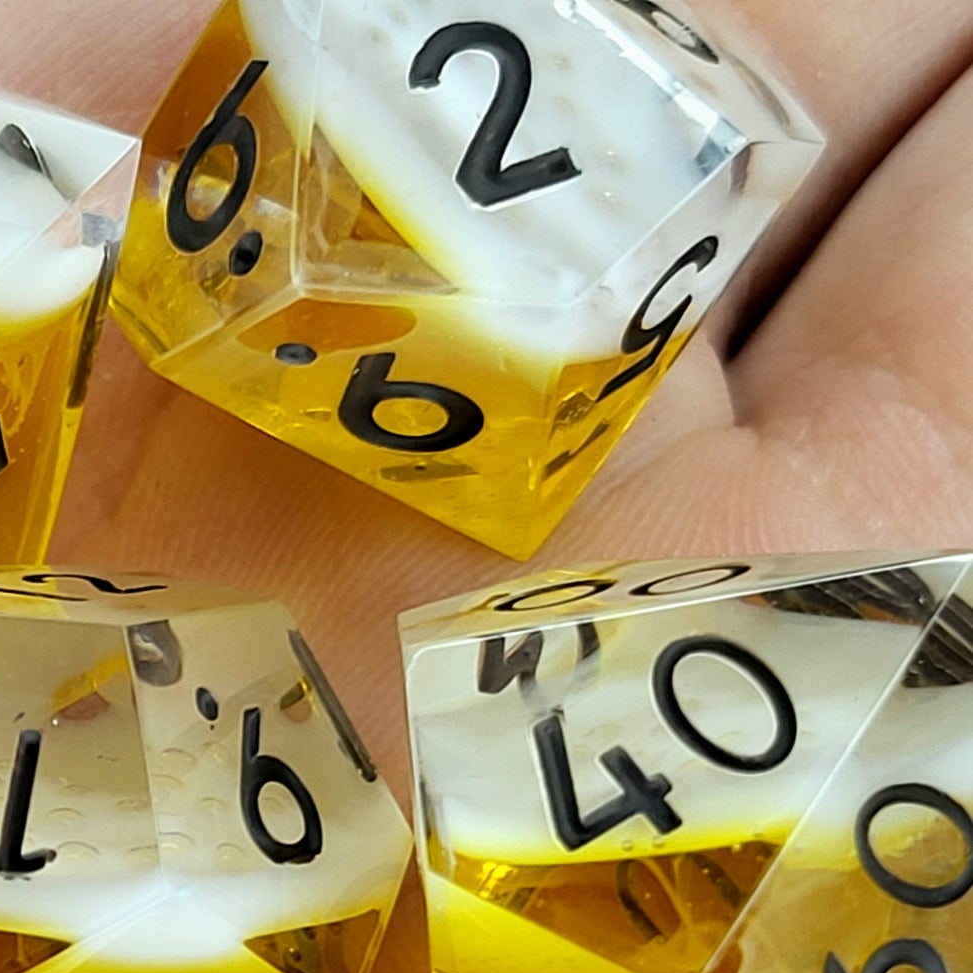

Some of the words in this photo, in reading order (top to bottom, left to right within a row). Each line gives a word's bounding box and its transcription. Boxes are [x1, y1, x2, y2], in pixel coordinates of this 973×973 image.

[408, 21, 583, 208] 2
[594, 235, 719, 404] 5
[532, 634, 798, 852] 40
